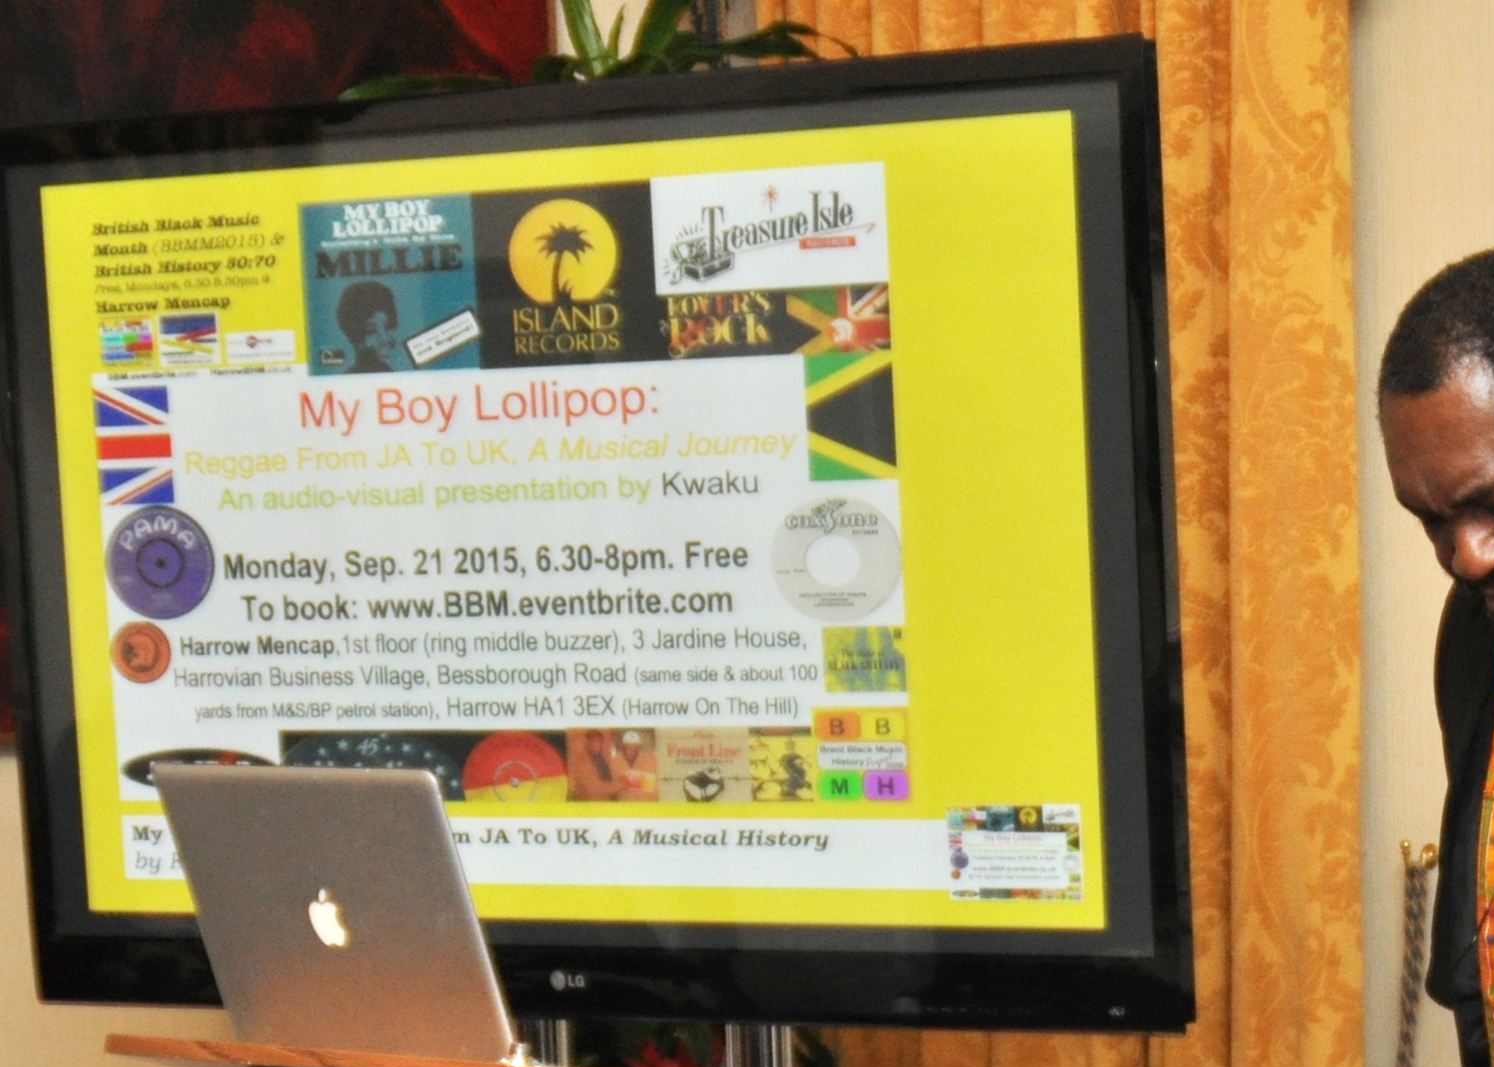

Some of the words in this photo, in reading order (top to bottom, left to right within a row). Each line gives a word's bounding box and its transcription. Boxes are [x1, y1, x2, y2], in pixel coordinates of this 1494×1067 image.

[343, 202, 380, 221] MY
[385, 198, 431, 218] BOY
[92, 221, 149, 236] British
[153, 216, 204, 232] Black
[207, 213, 260, 229] Music
[332, 214, 443, 238] LOLLIPOP
[701, 206, 808, 260] Treasure
[811, 191, 854, 234] Isle
[93, 242, 148, 257] Month
[270, 233, 285, 247] &
[94, 263, 152, 278] British
[157, 258, 222, 275] History
[225, 254, 277, 270] 50:70
[314, 243, 464, 279] MILLIE
[96, 299, 158, 314] Harrow
[163, 295, 231, 311] Mencap
[513, 303, 619, 334] ISLAND
[515, 327, 620, 355] RECORDS
[300, 390, 360, 437] My
[376, 386, 457, 433] Boy
[475, 380, 658, 427] Lollipop:
[184, 450, 287, 480] Reggae
[297, 446, 367, 471] From
[375, 444, 413, 469] JA
[422, 441, 457, 466] To
[466, 438, 517, 466] UK,
[528, 437, 549, 463] A
[559, 432, 669, 462] Musical
[678, 431, 798, 461] Journey
[218, 487, 251, 511] An
[263, 481, 424, 510] audio-visual
[435, 475, 608, 509] presentation
[618, 473, 650, 505] by
[661, 469, 759, 496] Kwaku
[120, 514, 197, 551] PAMA
[224, 551, 335, 585] Monday,
[345, 550, 404, 582] Sep.
[413, 549, 443, 576] 21
[454, 546, 527, 578] 2015,
[535, 543, 674, 577] 6.30-8pm.
[685, 541, 749, 569] Free
[240, 595, 275, 622] To
[283, 593, 358, 620] book:
[367, 588, 734, 619] www.BBM.eventbrite.com
[180, 636, 250, 656] Harrow
[375, 633, 416, 654] floor
[424, 630, 467, 658] (ring
[474, 629, 538, 653] middle
[545, 629, 626, 655] buzzer),
[632, 629, 645, 651] 3
[652, 627, 727, 650] Jardine
[734, 626, 807, 651] House,
[173, 667, 264, 688] Harrovian
[270, 666, 354, 687] Business
[359, 665, 430, 690] Village,
[437, 662, 567, 688] Bessborough
[574, 663, 627, 684] Road
[634, 665, 682, 686] (same
[687, 665, 718, 683] side
[723, 665, 735, 682] &
[740, 664, 784, 682] about
[791, 663, 818, 682] 100
[195, 704, 232, 722] yards
[236, 703, 268, 719] from
[272, 702, 332, 719] M&S/BP
[337, 702, 376, 721] petrol
[381, 701, 440, 721] station),
[447, 698, 517, 719] Harrow
[524, 696, 565, 717] HA1
[573, 695, 616, 716] 3EX
[621, 696, 690, 720] (Harrow
[695, 697, 720, 717] On
[726, 696, 760, 716] The
[765, 695, 799, 720] Hill)
[829, 717, 845, 736] B
[875, 717, 891, 736] B
[356, 737, 380, 756] 45
[709, 743, 742, 758] Line
[847, 744, 872, 754] Black
[831, 778, 849, 795] M
[878, 776, 894, 795] H
[132, 825, 163, 846] My
[479, 828, 510, 844] JA
[518, 827, 547, 845] To
[556, 827, 598, 849] UK,
[607, 828, 624, 846] A
[632, 828, 728, 846] Musical
[736, 829, 830, 852] History
[136, 850, 161, 875] by
[567, 974, 585, 988] LG
